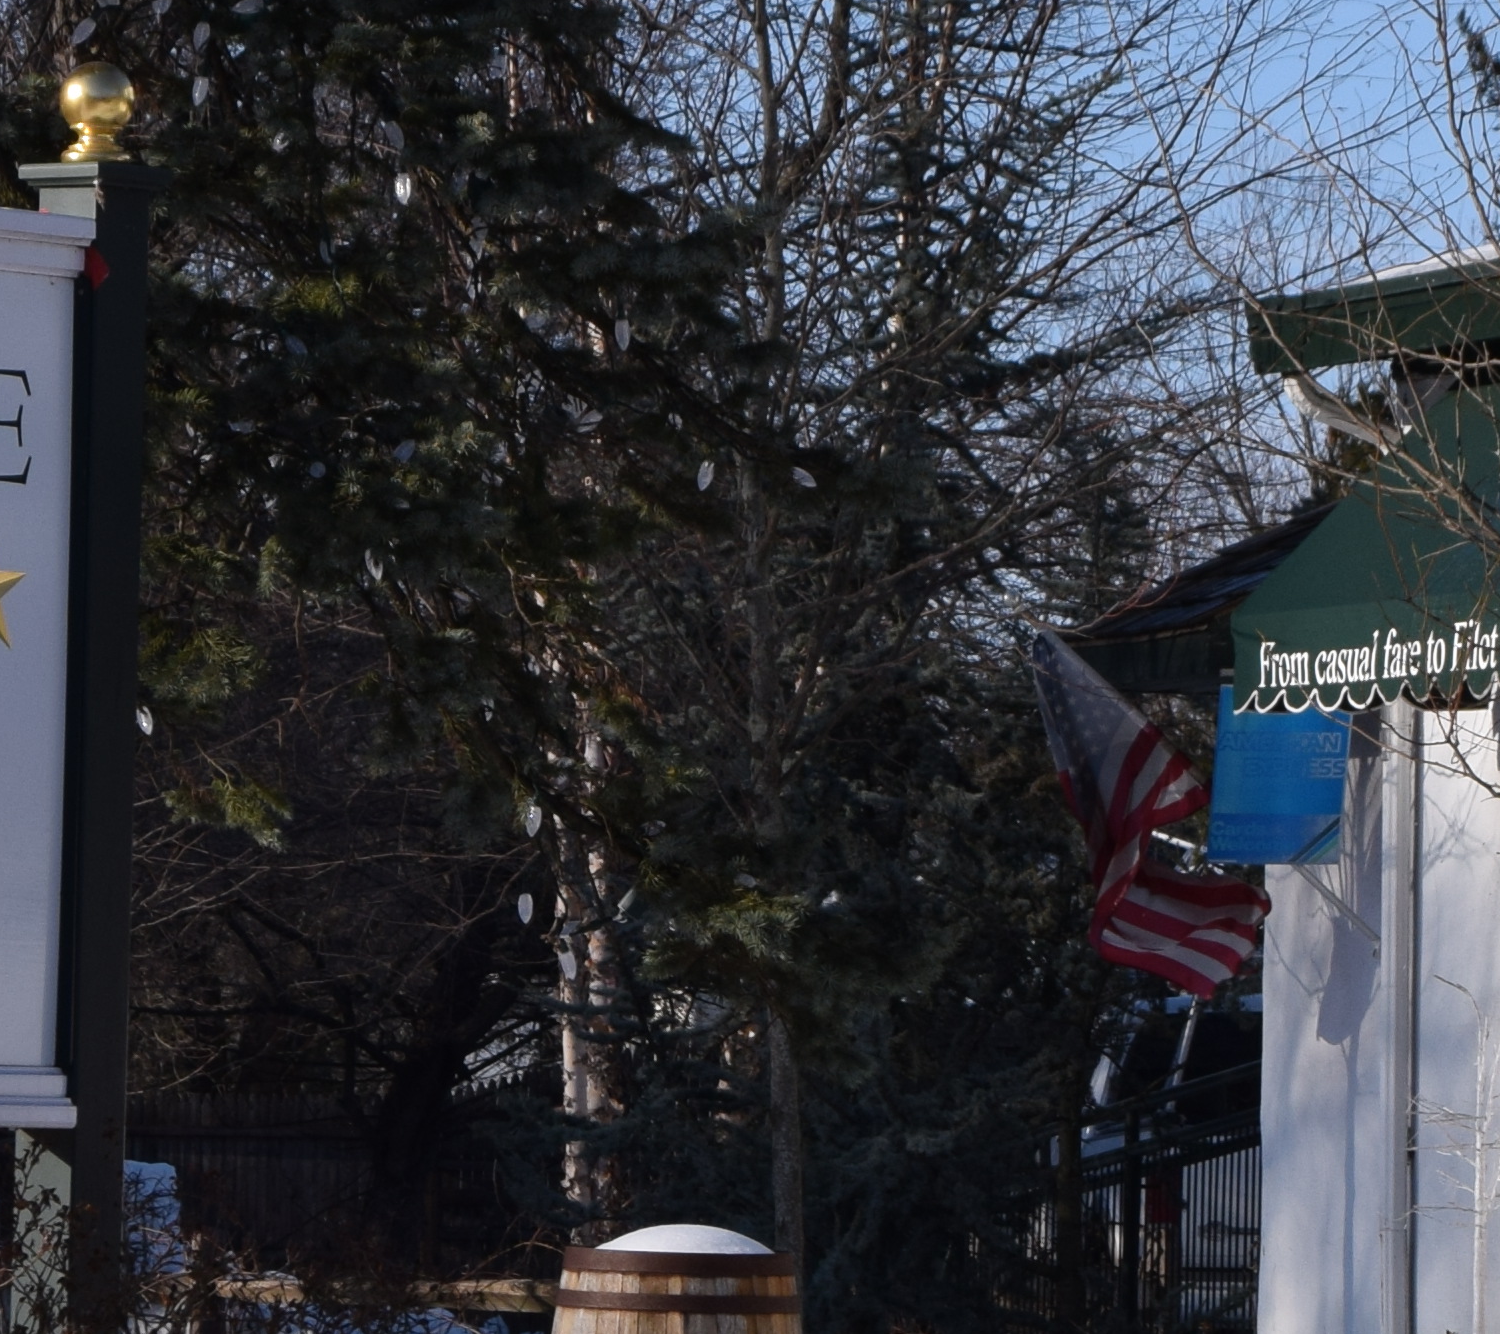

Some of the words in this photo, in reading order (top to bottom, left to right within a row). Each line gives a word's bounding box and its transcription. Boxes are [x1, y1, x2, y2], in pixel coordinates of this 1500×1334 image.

[1258, 641, 1310, 688] From
[1314, 629, 1379, 685] casual
[1382, 627, 1421, 680] fare
[1426, 630, 1446, 674] to
[1450, 618, 1498, 672] Filet
